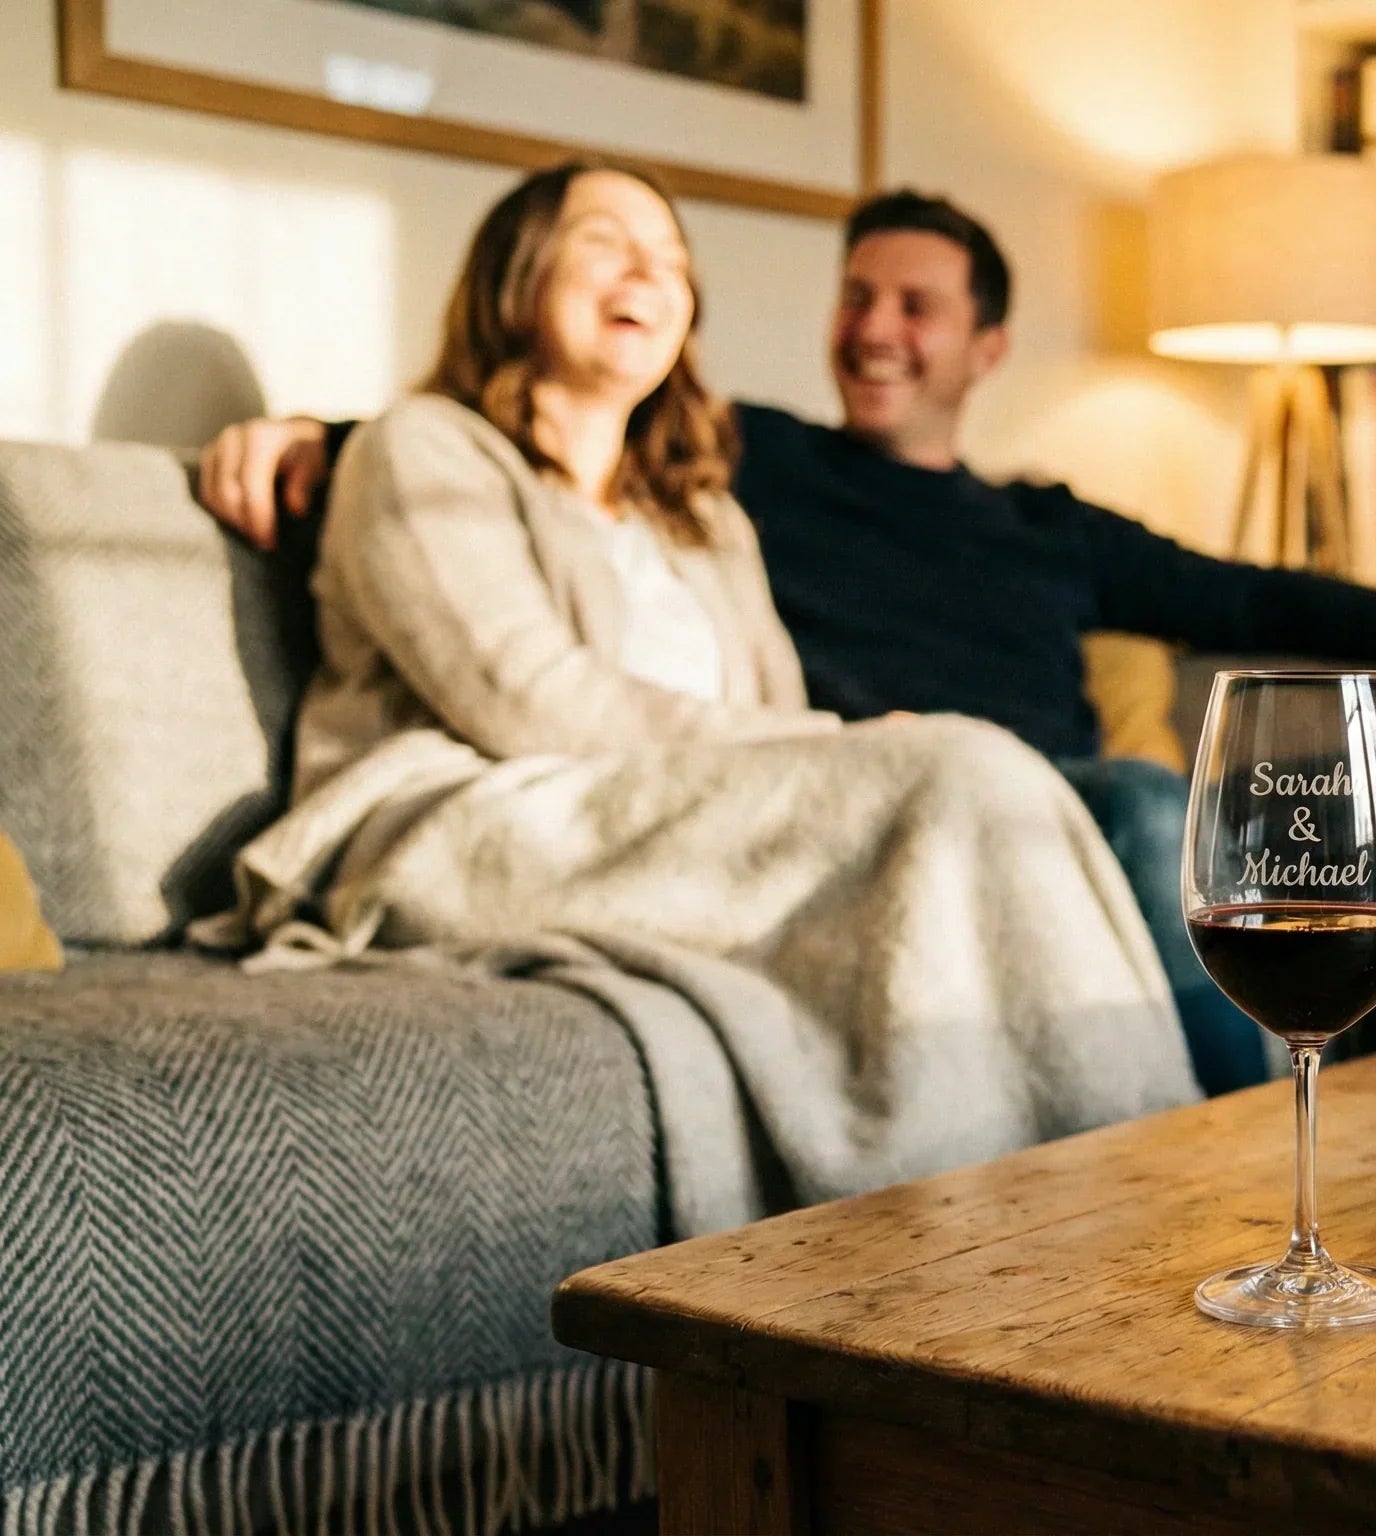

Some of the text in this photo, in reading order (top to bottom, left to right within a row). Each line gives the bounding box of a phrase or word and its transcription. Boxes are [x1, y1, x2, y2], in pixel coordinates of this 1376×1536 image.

[1249, 761, 1353, 796] Sarah
[1288, 806, 1322, 842] &
[1236, 848, 1372, 886] Michael
